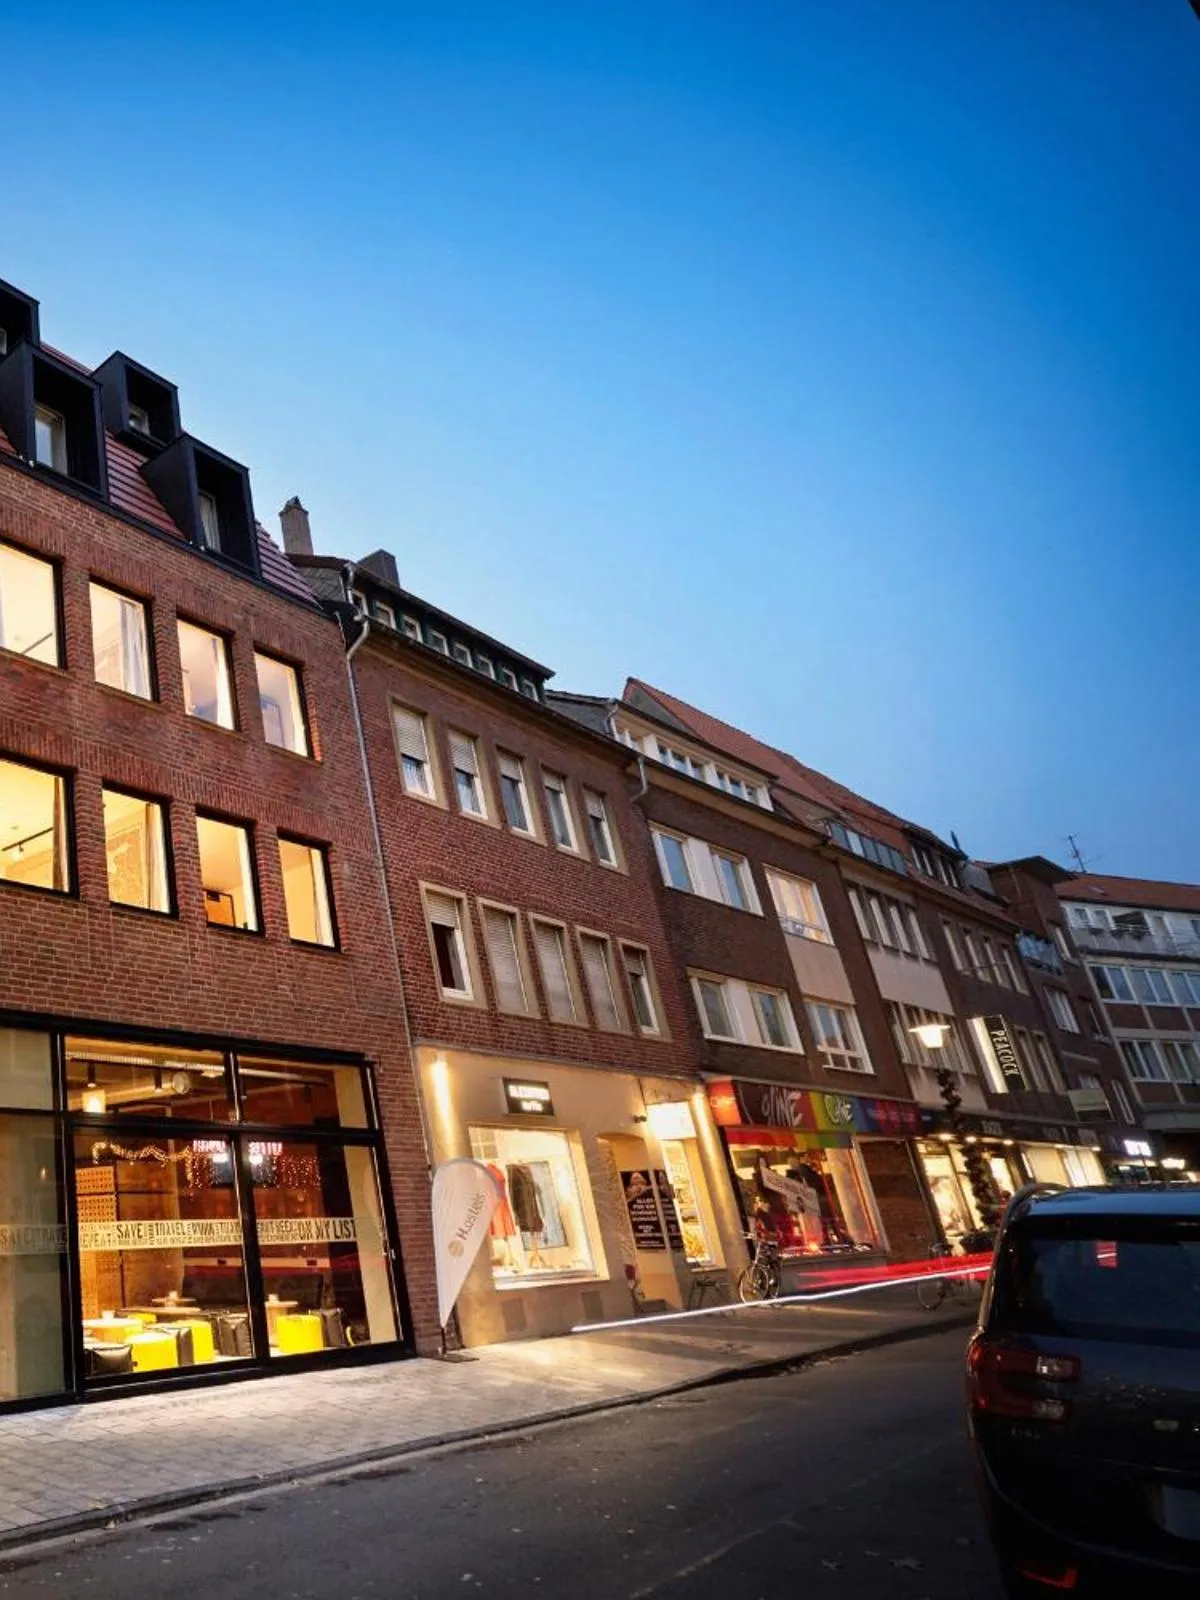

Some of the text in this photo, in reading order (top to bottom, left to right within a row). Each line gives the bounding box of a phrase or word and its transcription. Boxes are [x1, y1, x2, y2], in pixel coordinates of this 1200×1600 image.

[990, 1029, 1020, 1077] PEACOCK
[116, 1222, 144, 1240] SAVE
[333, 1219, 357, 1239] LIST
